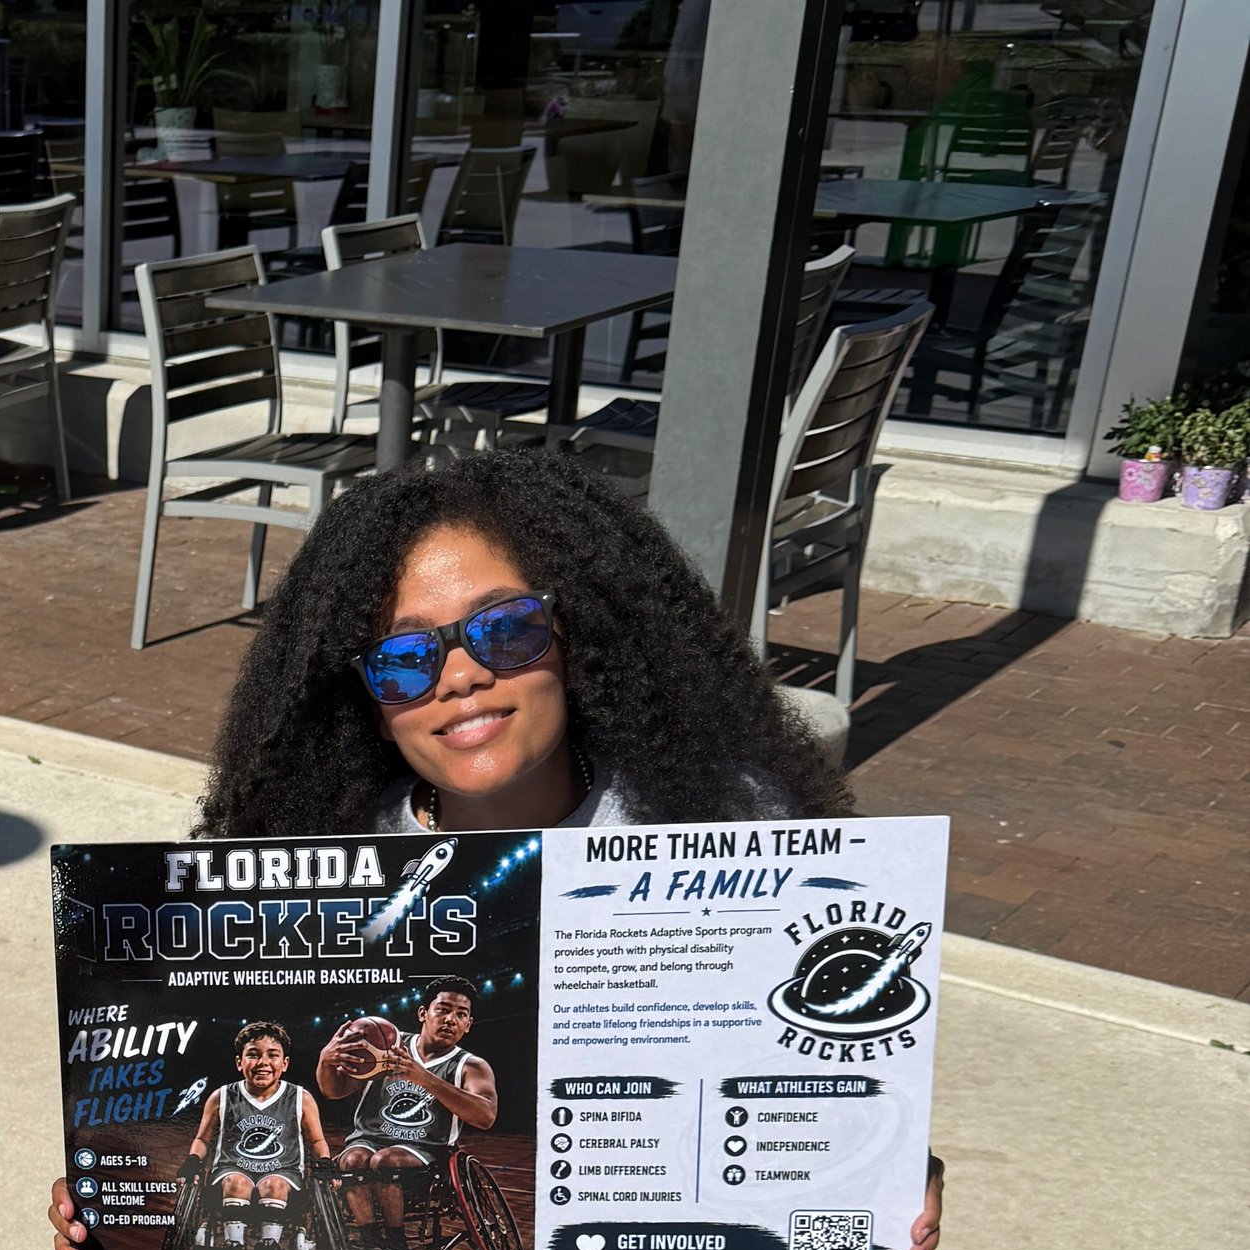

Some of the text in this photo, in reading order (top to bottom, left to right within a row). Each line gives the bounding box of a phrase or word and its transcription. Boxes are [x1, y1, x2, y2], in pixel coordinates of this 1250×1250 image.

[586, 834, 658, 863] MORE
[666, 831, 740, 859] THAN
[745, 830, 762, 857] A
[770, 828, 842, 856] TEAM
[164, 845, 386, 892] FLORIDA
[629, 867, 793, 903] A FAMILY
[103, 895, 478, 961] ROCKETS
[554, 926, 772, 940] The Florida Rockets Adaptive Sports program
[554, 943, 734, 959] provides youth with physical disability
[554, 960, 734, 975] to compete, grow, and belong through
[168, 968, 403, 986] ADAPTIVE WHEELCHAIR BASKETBALL
[553, 979, 658, 990] wheelchair basketball.
[553, 1001, 757, 1013] Our athletes build confidence, develop skills,
[68, 1004, 129, 1027] WHERE
[552, 1020, 570, 1030] and
[572, 1020, 601, 1029] create
[603, 1019, 637, 1031] lifelong
[639, 1018, 691, 1029] friendships
[692, 1017, 701, 1027] in
[711, 1017, 763, 1028] supportive
[67, 1020, 197, 1065] ABILITY
[552, 1034, 691, 1047] and empowering environment.
[778, 1026, 916, 1063] ROCKETS
[88, 1059, 165, 1092] TAKES
[565, 1082, 652, 1095] WHO CAN JOIN
[737, 1080, 867, 1094] WHAT ATHLETES GAIN
[73, 1087, 172, 1128] FLIGHT
[579, 1111, 642, 1122] SPINA BIFIDA
[757, 1112, 818, 1123] CONFIDENCE
[380, 1121, 427, 1140] ROCKETS
[579, 1138, 660, 1149] CEREBRAL PALSY
[756, 1141, 830, 1152] INDEPENDENCE
[100, 1155, 124, 1166] AGES
[578, 1165, 667, 1176] LIMB DIFFERENCES
[755, 1170, 811, 1181] TEAMWORK
[101, 1182, 177, 1193] ALL SKILL LEVELS
[102, 1195, 145, 1206] WELCOME
[578, 1191, 682, 1202] SPINAL CORD INJURIES
[103, 1213, 175, 1226] CO-ED PROGRAM
[617, 1234, 726, 1250] GET INVOLVED
